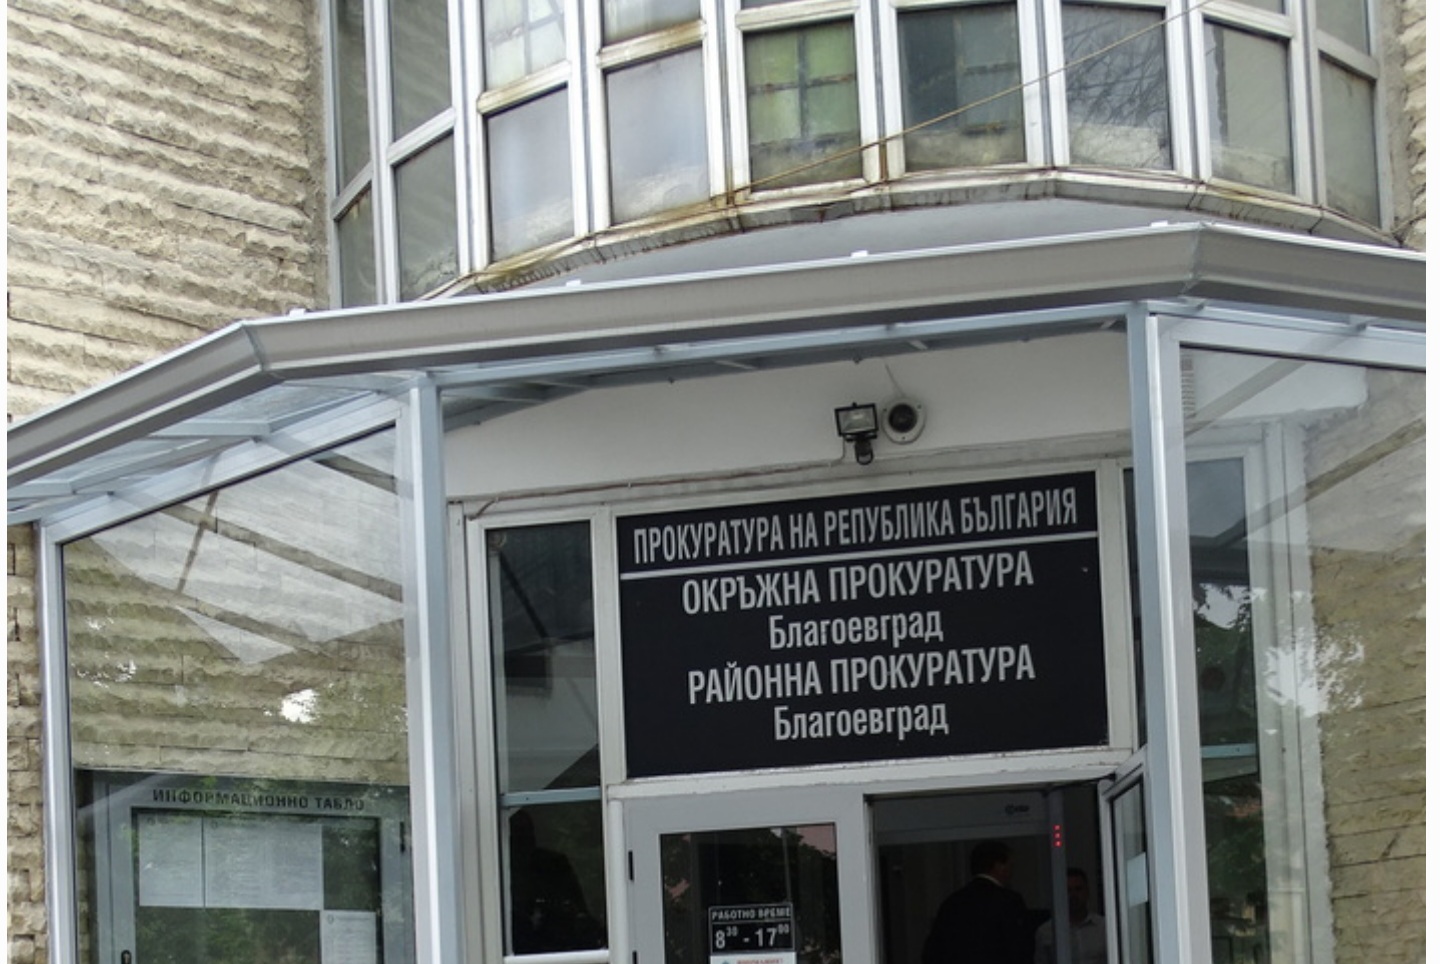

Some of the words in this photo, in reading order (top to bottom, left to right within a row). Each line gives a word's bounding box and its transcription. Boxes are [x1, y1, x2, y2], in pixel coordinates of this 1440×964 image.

[633, 516, 784, 564] ПРОКУРАТУРА
[789, 513, 819, 549] НА
[823, 499, 955, 546] РЕПУБЛИКА
[960, 487, 1078, 534] БЪЛГАРИЯ
[682, 573, 821, 615] ОКРЪЖНА
[828, 550, 1035, 602] ПРОКУРАТУРА
[768, 610, 944, 650] Благоевград
[688, 660, 823, 705] РАЙОННА
[830, 644, 1036, 695] ПРОКУРАТУРА
[773, 703, 950, 741] Благоевград
[152, 788, 309, 809] ИНФОРМАЦИОННО
[315, 796, 365, 811] ТАБЛО
[711, 909, 756, 920] РАБОТНО
[758, 907, 791, 919] ВРЕМЕ
